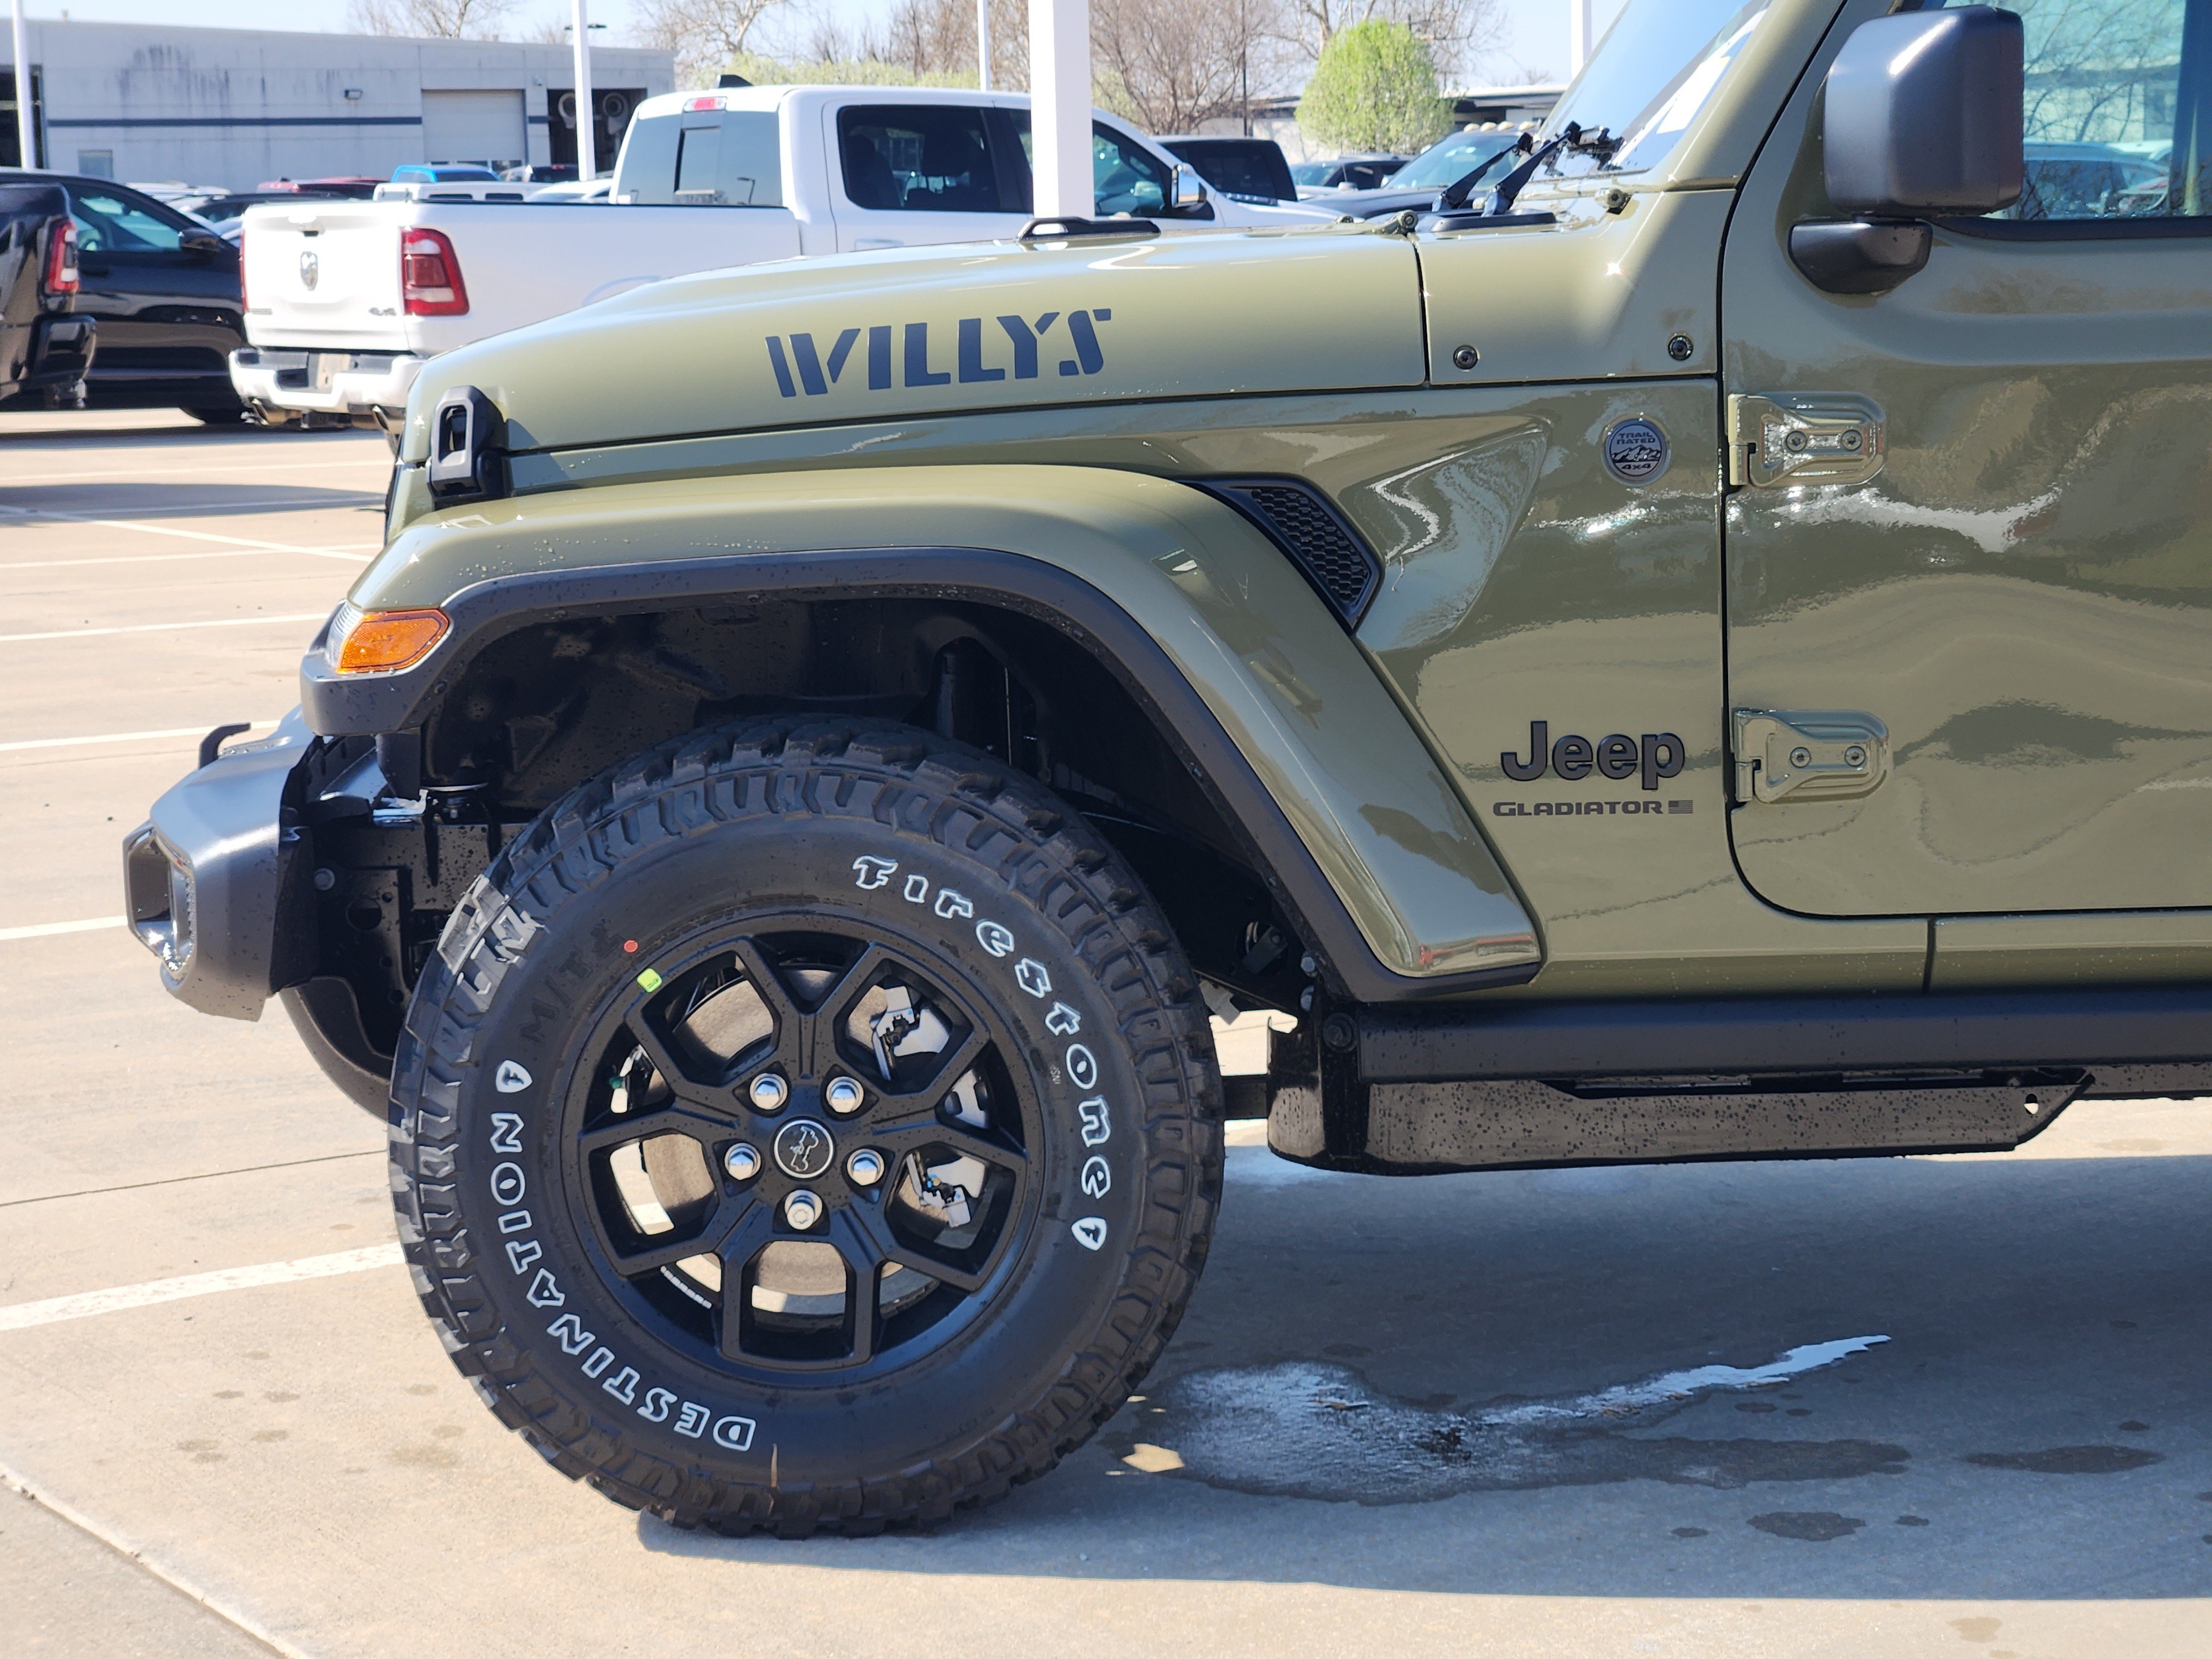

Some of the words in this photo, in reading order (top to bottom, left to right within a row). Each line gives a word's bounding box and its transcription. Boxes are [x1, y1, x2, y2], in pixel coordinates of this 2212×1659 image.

[765, 309, 1112, 397] WILLYS
[1501, 721, 1685, 790] Jeep
[1493, 801, 1662, 816] GLADIATOR
[852, 854, 1112, 1199] Firestone
[490, 1112, 758, 1452] DESTINATION
